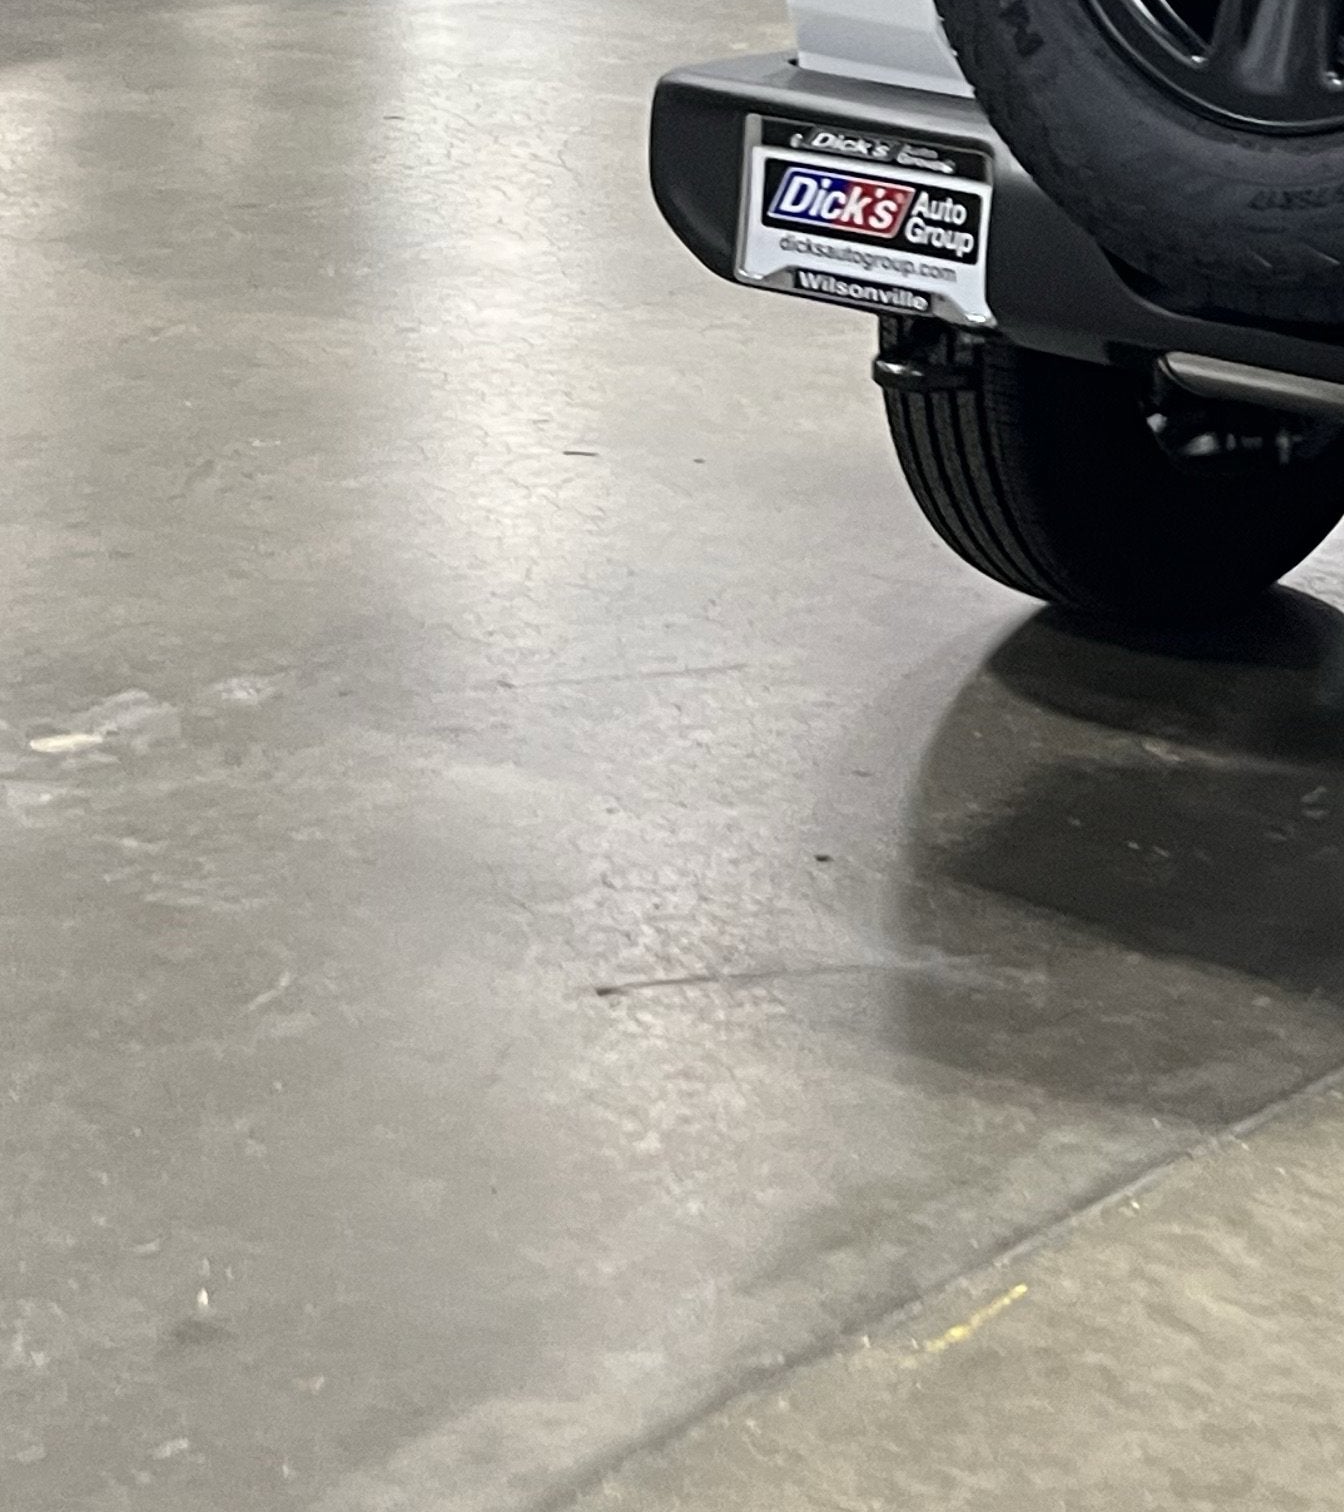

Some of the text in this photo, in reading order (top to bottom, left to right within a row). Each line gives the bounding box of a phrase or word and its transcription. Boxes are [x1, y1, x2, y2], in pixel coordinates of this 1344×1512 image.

[778, 175, 899, 230] Dick's
[911, 191, 967, 226] Auto
[779, 233, 958, 283] dicksautogroup.com
[905, 217, 975, 258] Group
[799, 271, 929, 311] Wilsonville
